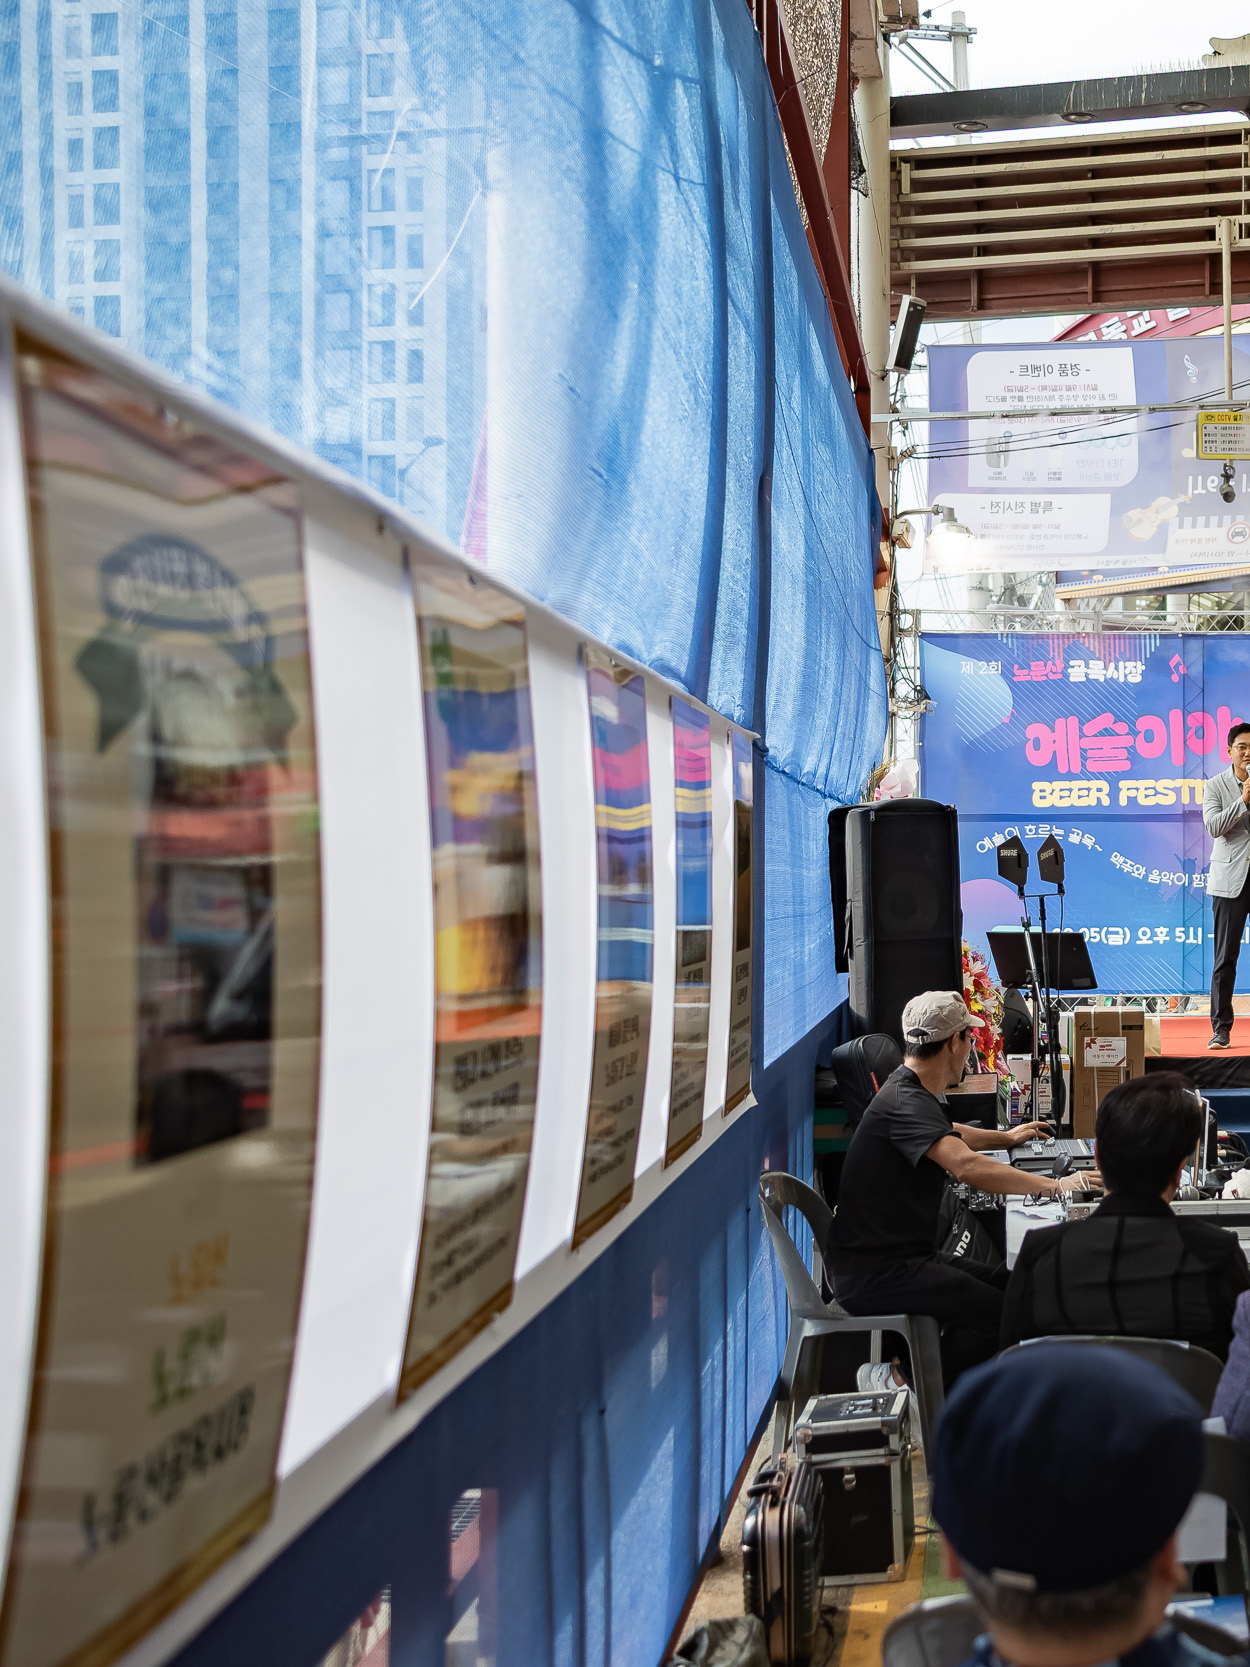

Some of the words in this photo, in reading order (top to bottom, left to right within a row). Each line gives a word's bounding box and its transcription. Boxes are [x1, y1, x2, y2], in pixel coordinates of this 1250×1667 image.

[960, 660, 974, 675] 제
[978, 660, 1002, 675] 2회
[1012, 659, 1065, 682] 노룬산
[1067, 659, 1146, 683] 골목시장
[1025, 706, 1244, 774] 예술이야
[1031, 779, 1111, 808] BEER
[1000, 848, 1019, 858] SHURE
[1109, 851, 1147, 880] 맥주와
[1148, 868, 1189, 887] 음악이
[1192, 872, 1211, 888] 함
[1136, 926, 1171, 945] 오후
